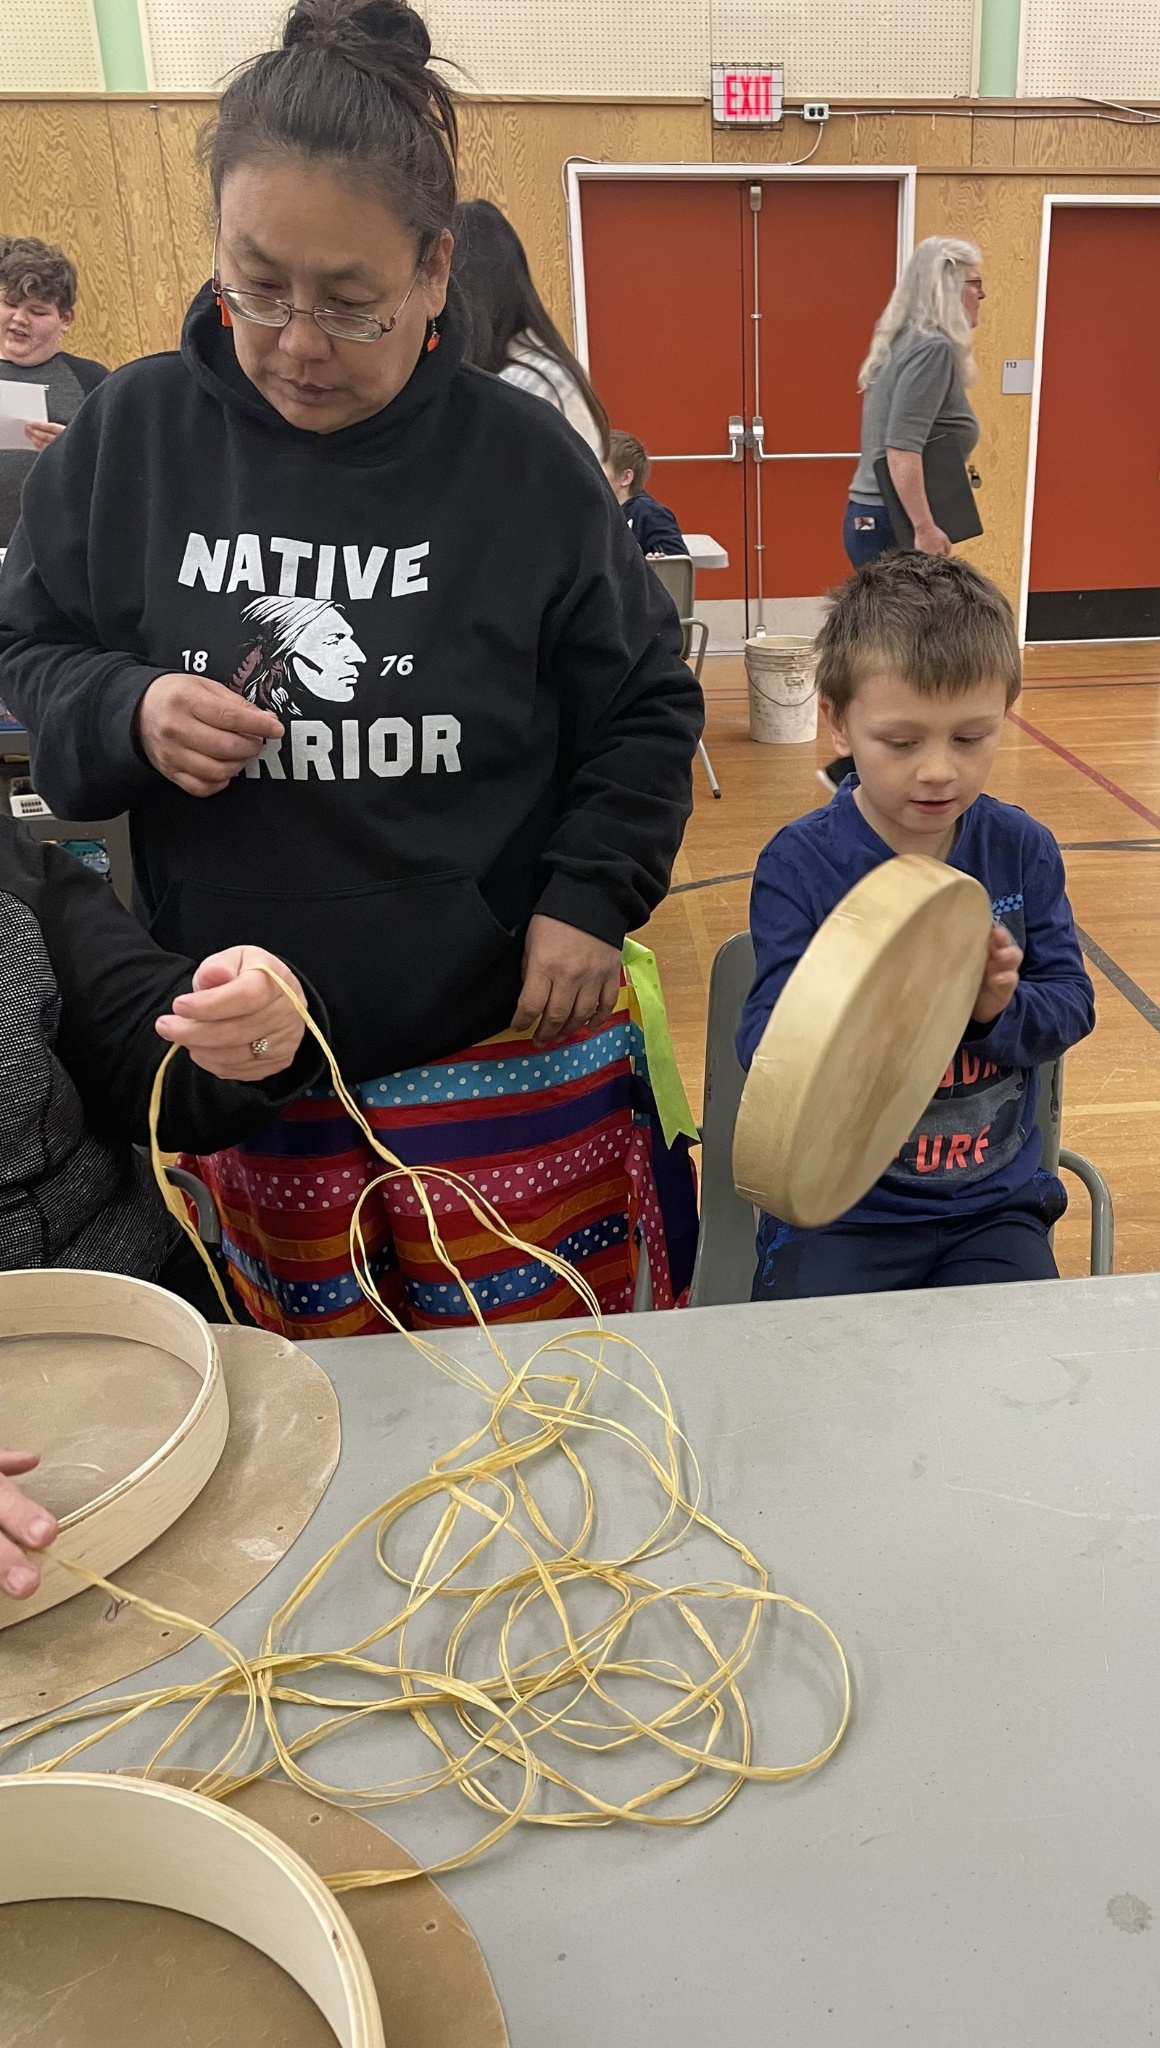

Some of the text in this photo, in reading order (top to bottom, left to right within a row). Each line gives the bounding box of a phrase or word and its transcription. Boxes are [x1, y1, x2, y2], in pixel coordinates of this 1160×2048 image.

[726, 75, 772, 116] EXIT
[1005, 361, 1017, 369] 113
[177, 532, 430, 600] NATIVE
[181, 650, 414, 677] 18 76
[245, 714, 462, 781] RRIOR
